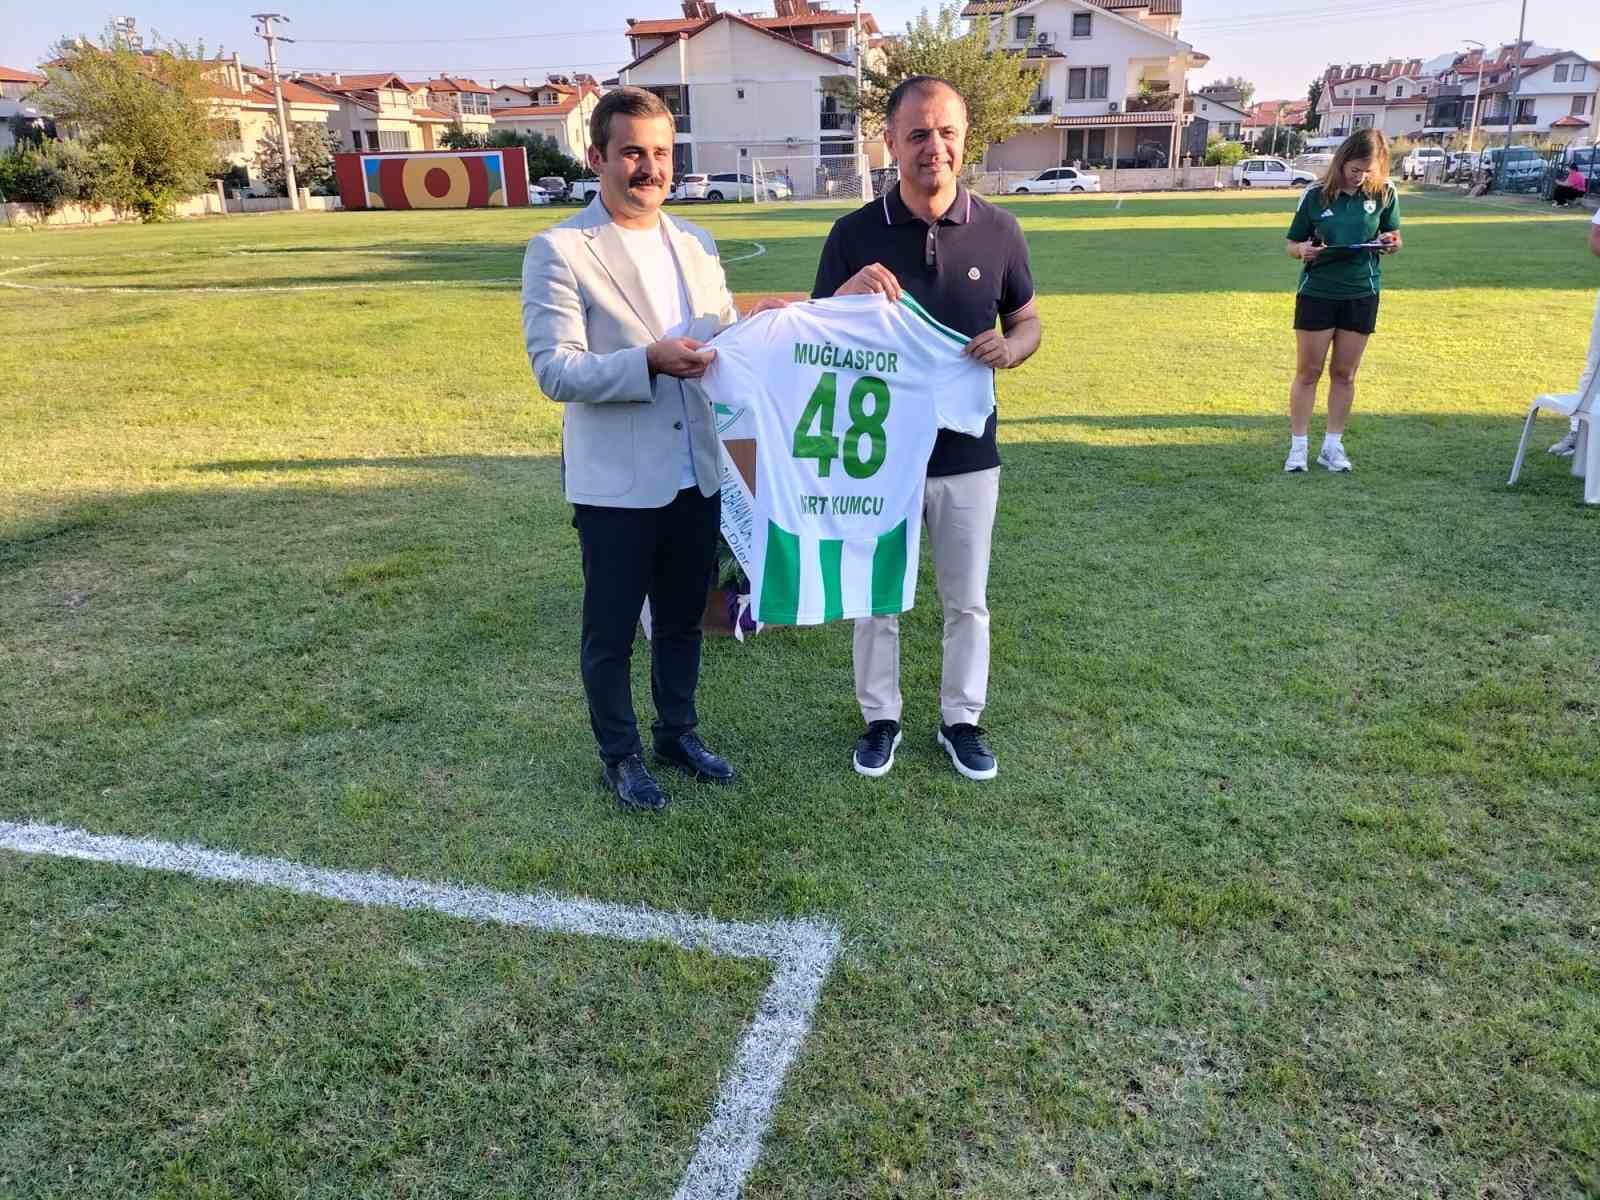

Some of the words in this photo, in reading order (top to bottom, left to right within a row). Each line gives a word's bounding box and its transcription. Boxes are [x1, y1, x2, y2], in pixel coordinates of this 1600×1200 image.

[794, 341, 898, 373] MUĞLASPOR
[793, 371, 890, 480] 48
[832, 495, 883, 516] KUMCU
